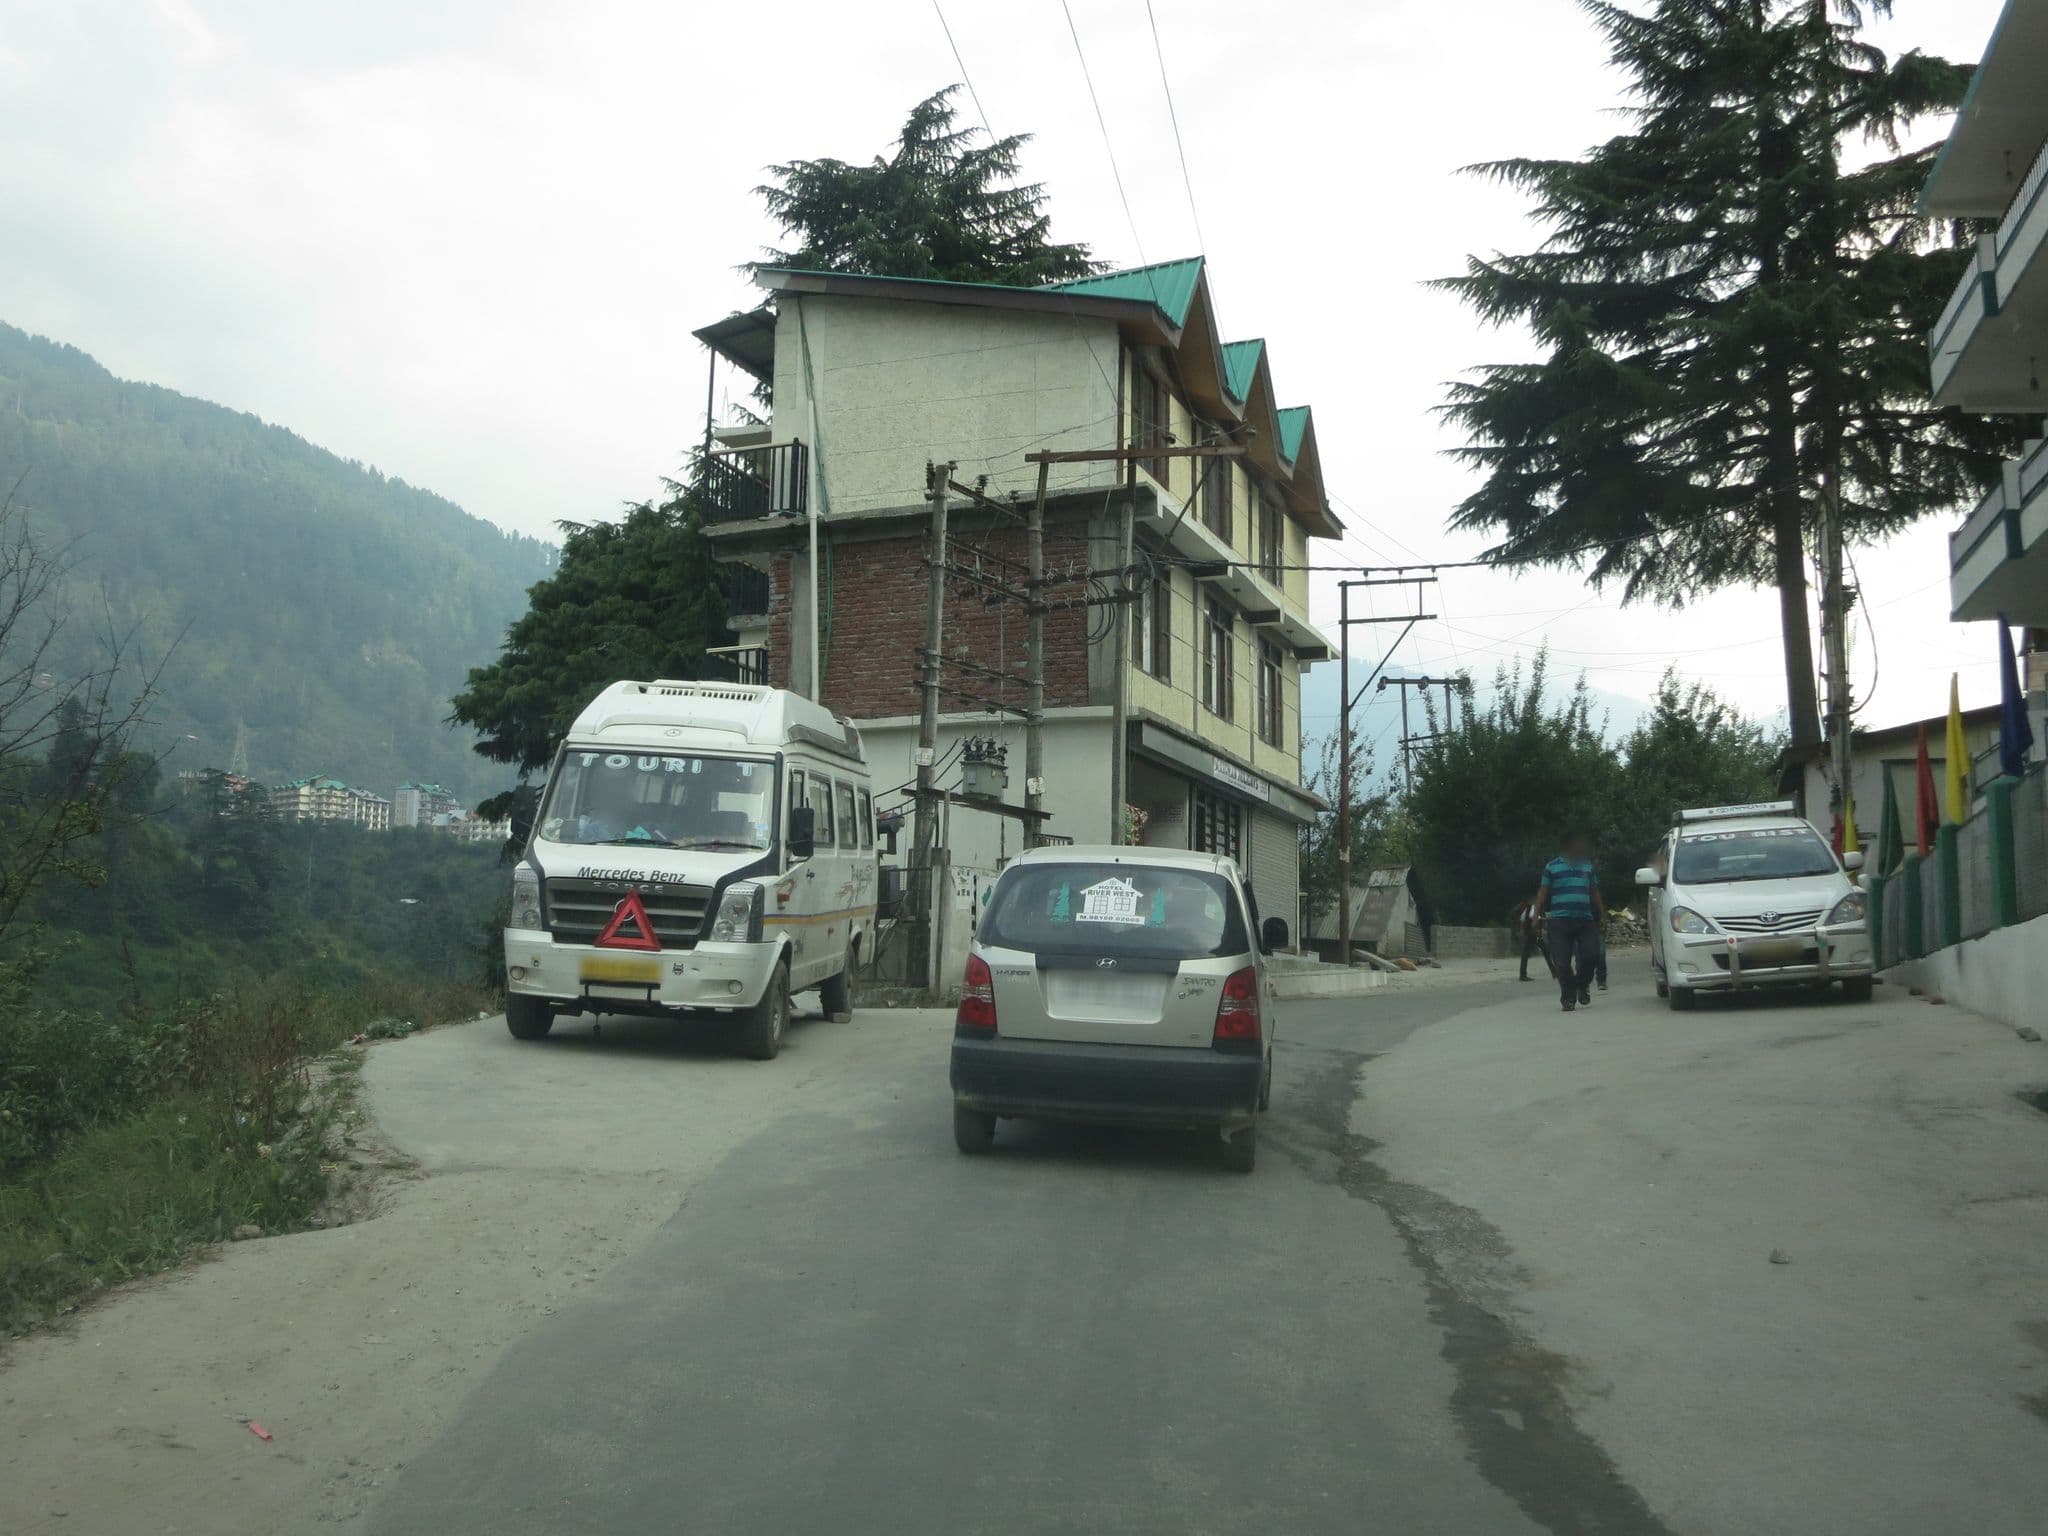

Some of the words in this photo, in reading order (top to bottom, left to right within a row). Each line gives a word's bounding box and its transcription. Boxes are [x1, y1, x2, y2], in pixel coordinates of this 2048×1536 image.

[577, 866, 645, 881] Mercedes
[649, 870, 686, 884] Benz
[1087, 889, 1111, 897] RIVER
[1113, 890, 1136, 898] WEST
